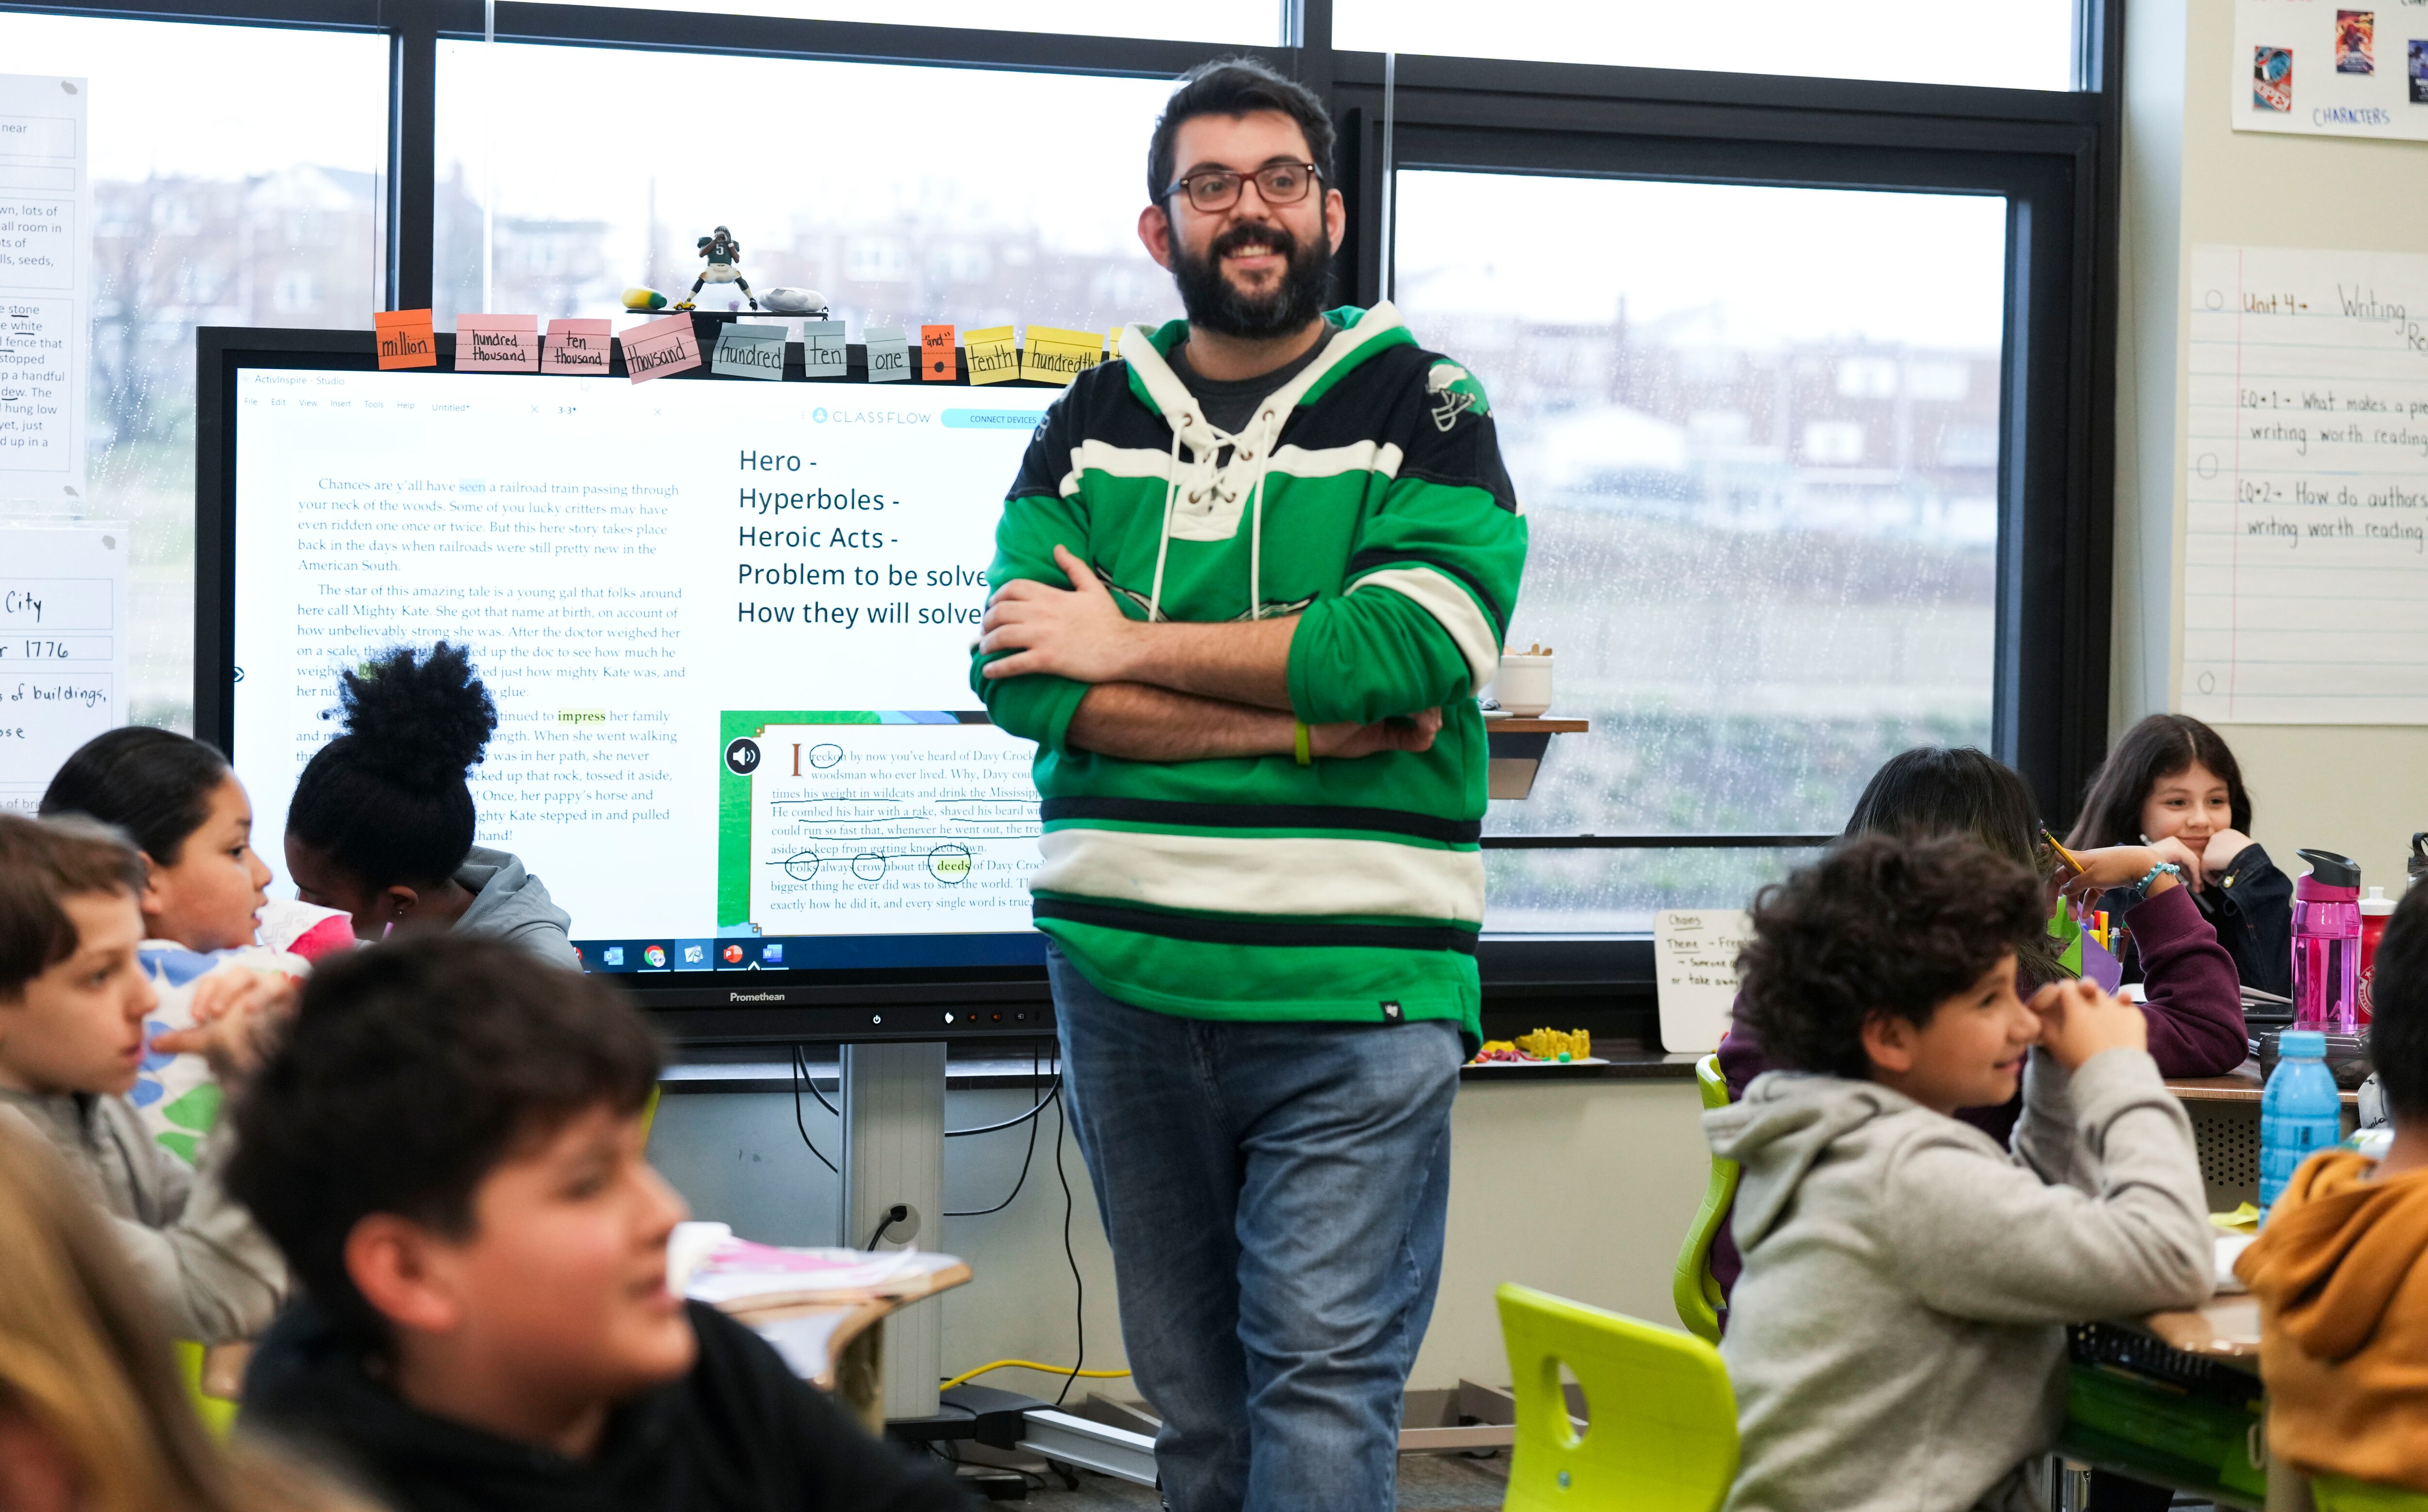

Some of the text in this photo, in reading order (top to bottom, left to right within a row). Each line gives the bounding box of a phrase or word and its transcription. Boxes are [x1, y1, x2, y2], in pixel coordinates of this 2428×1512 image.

[2, 124, 27, 133] near
[22, 205, 43, 216] lots
[46, 206, 58, 217] of
[18, 224, 48, 233] room
[52, 223, 62, 233] in
[15, 237, 26, 248] of
[716, 244, 724, 255] 5
[18, 255, 53, 268] seeds,
[9, 305, 39, 315] stone
[2243, 292, 2277, 314] Unit
[2337, 282, 2406, 336] Writing
[11, 320, 42, 331] white
[6, 336, 62, 349] fence that
[382, 331, 427, 357] million
[472, 329, 518, 347] hundred
[567, 330, 586, 350] ten
[472, 346, 525, 362] thousand
[554, 348, 602, 366] thousand
[627, 336, 686, 373] thousand
[719, 336, 781, 370] hundred
[810, 336, 842, 365] ten
[970, 344, 1015, 371] tenth
[876, 352, 903, 370] one
[22, 370, 65, 381] handful
[254, 375, 307, 386] ActivInspire
[317, 376, 345, 385] Studio
[1, 386, 52, 398] dew. The
[2302, 390, 2336, 411] What
[2347, 393, 2387, 412] makes
[2395, 402, 2403, 412] a
[5, 403, 57, 416] hung low
[397, 402, 415, 410] Help
[833, 411, 931, 424] CLASSFLOW
[1007, 416, 1037, 424] DEVICES
[11, 438, 25, 449] up
[29, 437, 38, 447] in
[2251, 421, 2306, 456] writing
[2320, 424, 2363, 442] worth
[741, 450, 801, 471] Hero
[319, 478, 371, 490] Chances
[396, 480, 422, 494] y'all
[427, 480, 455, 491] have
[500, 482, 547, 493] railroad
[552, 483, 579, 493] train
[583, 484, 628, 497] passing
[632, 484, 678, 498] through
[2296, 481, 2328, 504] How
[2338, 486, 2358, 506] do
[2368, 486, 2428, 508] authors
[740, 487, 884, 515] Hyperboles
[740, 526, 821, 548] Heroic
[829, 527, 883, 549] Acts
[2248, 516, 2423, 554] writing worth reading
[739, 563, 844, 585] Problem
[854, 566, 879, 586] to
[889, 564, 917, 586] be
[318, 584, 341, 595] The
[345, 586, 368, 595] star
[371, 585, 383, 595] of
[387, 585, 409, 596] this
[412, 586, 465, 599] amazing
[469, 586, 490, 597] tale
[494, 587, 504, 596] is
[517, 589, 556, 601] young
[559, 587, 576, 600] gal
[581, 587, 604, 598] that
[608, 587, 636, 598] folks
[640, 588, 681, 598] around
[6, 590, 42, 623] City
[739, 601, 981, 629] How they will solve
[26, 640, 68, 658] 1776
[11, 683, 106, 708] of buildings,
[543, 710, 670, 724] to impress her family
[792, 743, 802, 777] I
[811, 751, 846, 762] reckon
[850, 750, 862, 764] by
[891, 751, 924, 764] you've
[928, 750, 956, 761] heard
[959, 750, 971, 760] of
[974, 751, 997, 764] Davy
[790, 862, 817, 872] Folks
[820, 860, 853, 873] always
[886, 860, 913, 871] about
[918, 861, 933, 871] the
[937, 860, 970, 871] deeds
[973, 860, 985, 871] of
[987, 860, 1013, 873] Davy
[730, 991, 785, 1002] Promethean
